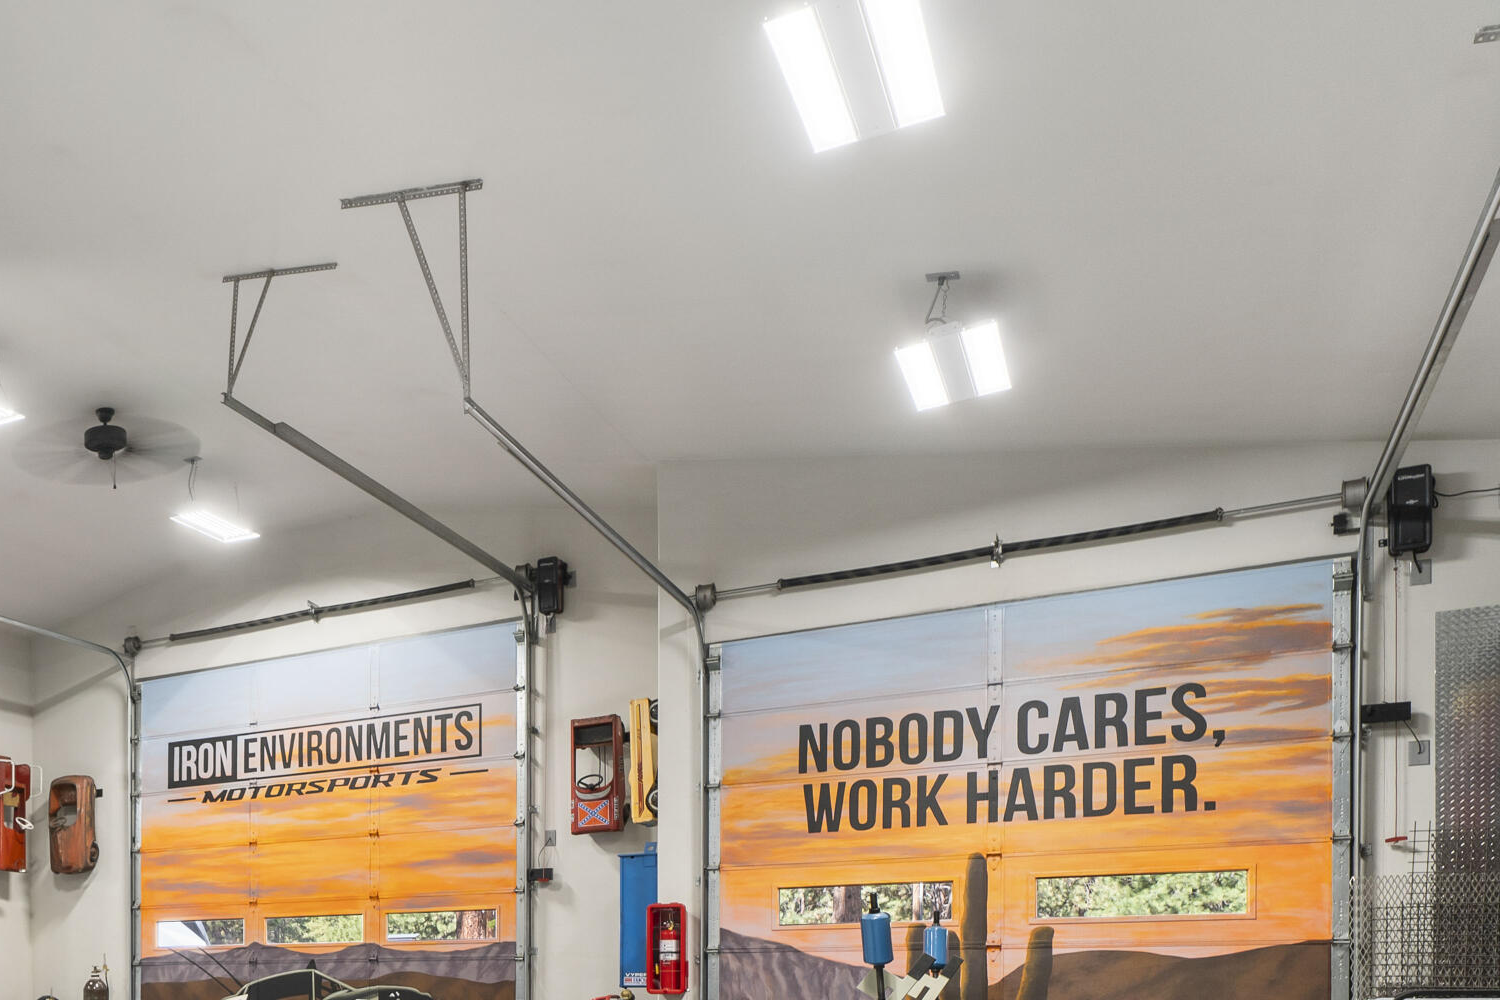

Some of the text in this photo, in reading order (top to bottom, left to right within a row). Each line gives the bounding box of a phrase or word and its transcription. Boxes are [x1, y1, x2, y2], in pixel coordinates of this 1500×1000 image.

[173, 710, 474, 782] IRON ENVIRONMENTS
[798, 683, 1226, 774] NOBODY CARES,
[202, 769, 440, 803] MOTORSPORTS
[803, 753, 1217, 834] WORK HARDER.
